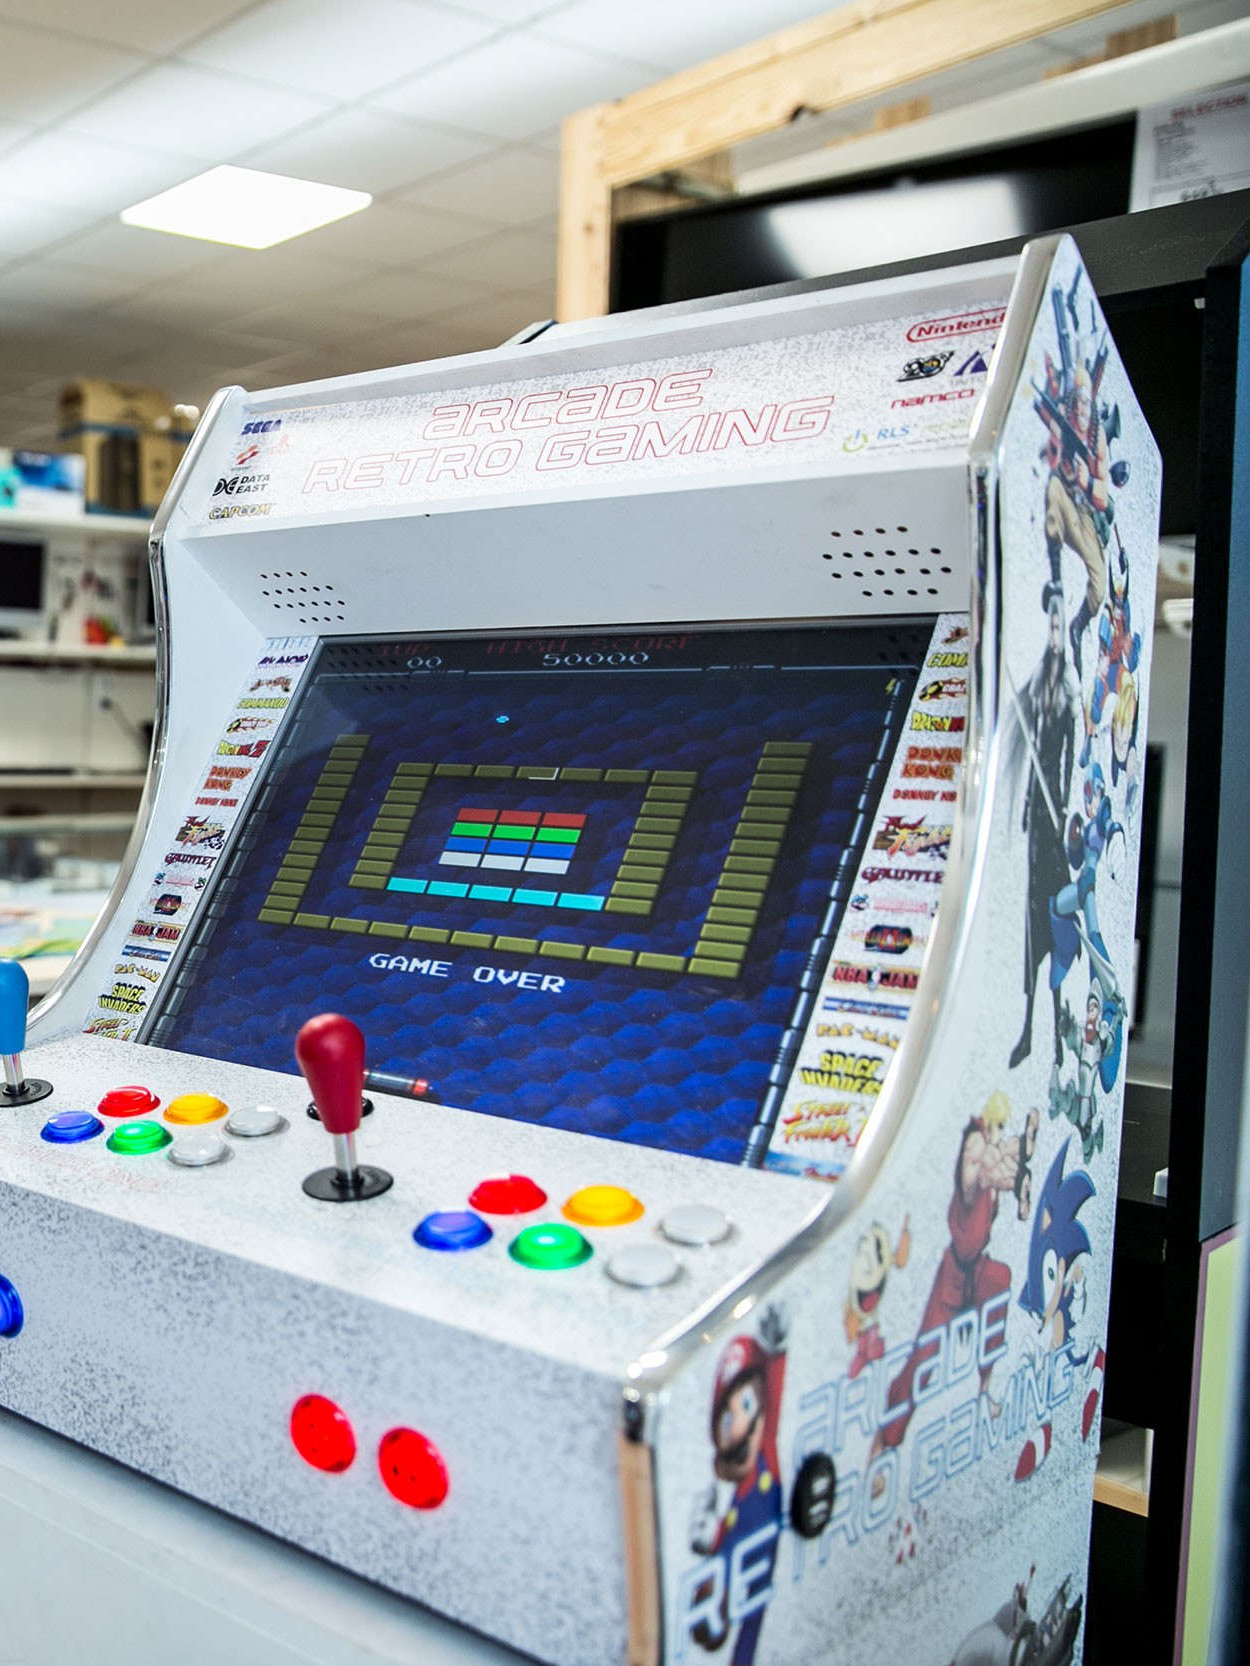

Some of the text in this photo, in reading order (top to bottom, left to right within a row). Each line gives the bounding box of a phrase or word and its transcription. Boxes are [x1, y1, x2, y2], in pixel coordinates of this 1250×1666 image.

[916, 312, 1006, 338] Nintend
[240, 419, 282, 436] SEGA
[302, 438, 524, 494] RETRO
[240, 474, 270, 485] DATA
[235, 484, 269, 495] EAST
[209, 503, 272, 520] CAPCOM
[542, 651, 650, 667] 50000
[900, 763, 955, 781] KONG
[203, 778, 233, 791] KONG
[861, 866, 945, 884] GAUNTLE
[156, 927, 181, 941] JAM
[114, 963, 161, 983] PAC-MAN
[368, 952, 567, 993] GAME OVER
[111, 982, 146, 1002] SPACE
[98, 994, 148, 1015] INVADERS
[819, 1050, 884, 1080] SPACE
